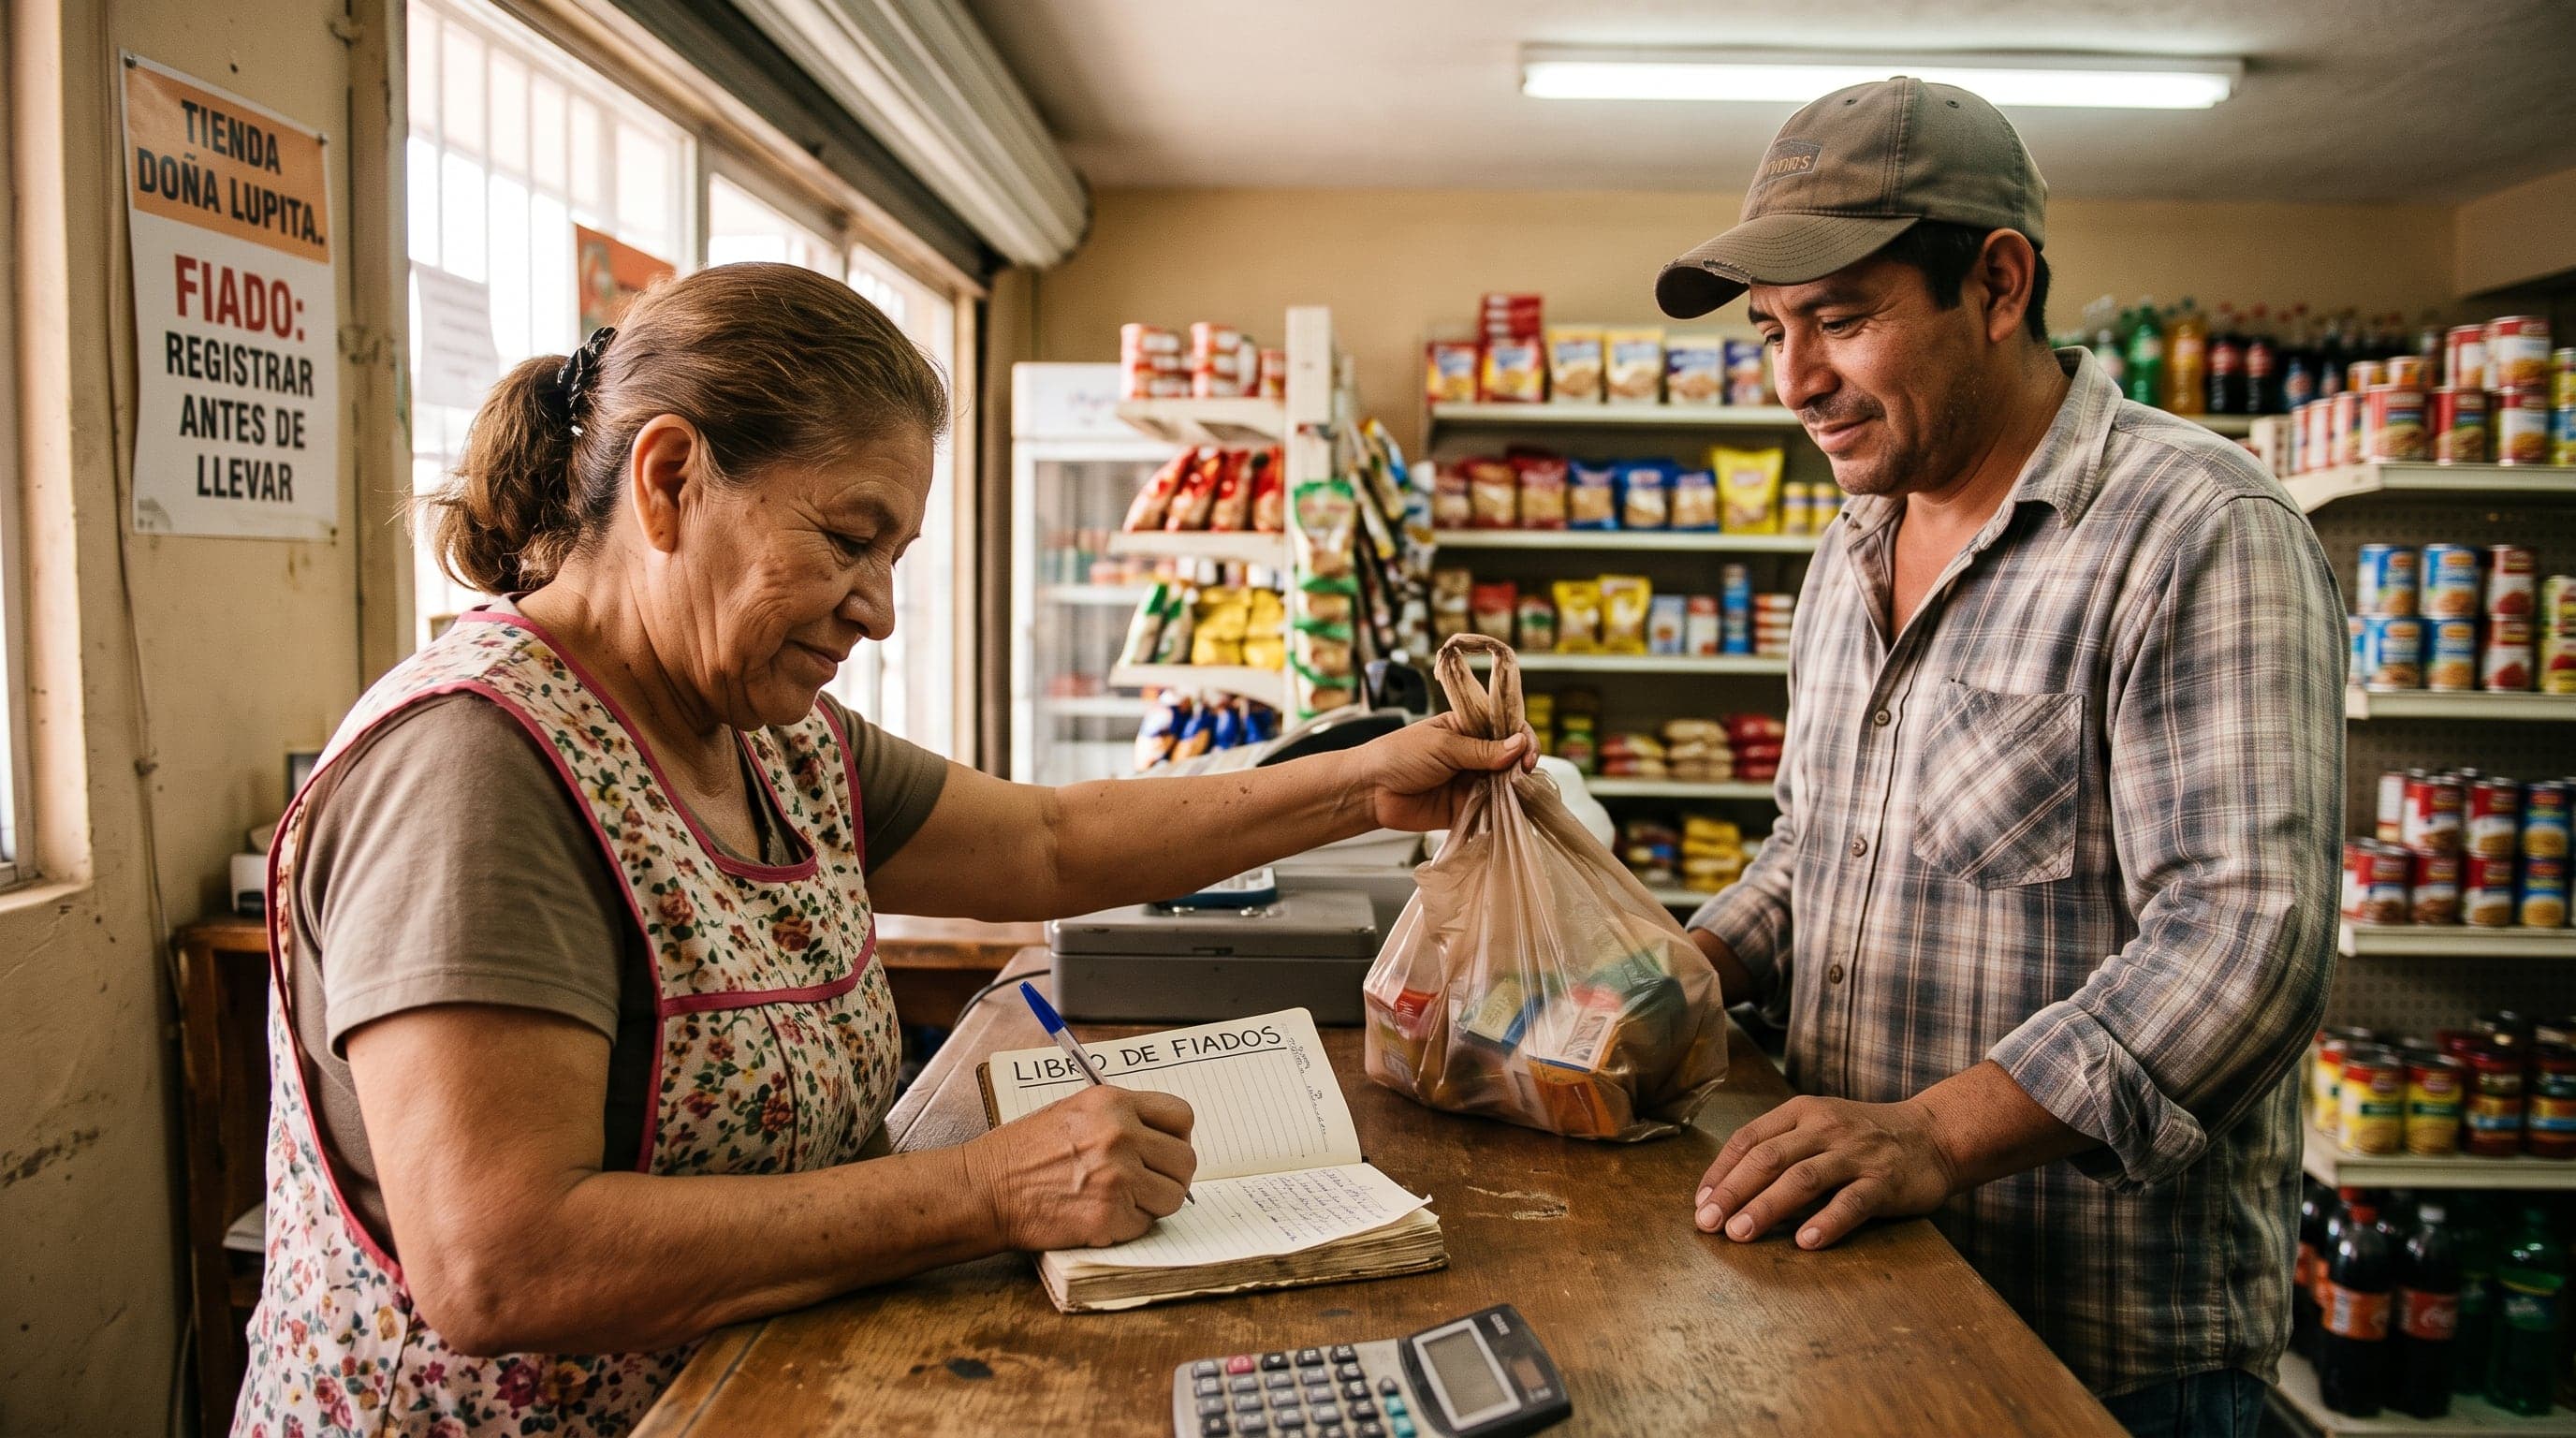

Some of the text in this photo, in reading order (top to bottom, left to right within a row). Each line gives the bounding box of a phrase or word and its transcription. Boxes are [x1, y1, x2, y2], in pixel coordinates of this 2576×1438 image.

[182, 99, 282, 175] TIENDA
[137, 147, 325, 245] DOÑA LUPITA.
[175, 254, 304, 342] FIADO:
[166, 330, 314, 398] REGISTRAR
[180, 394, 305, 449] ANTES DE
[197, 455, 293, 502] LLEVAR
[1120, 1044, 1159, 1066] DE
[1172, 1026, 1281, 1059] FIADOS
